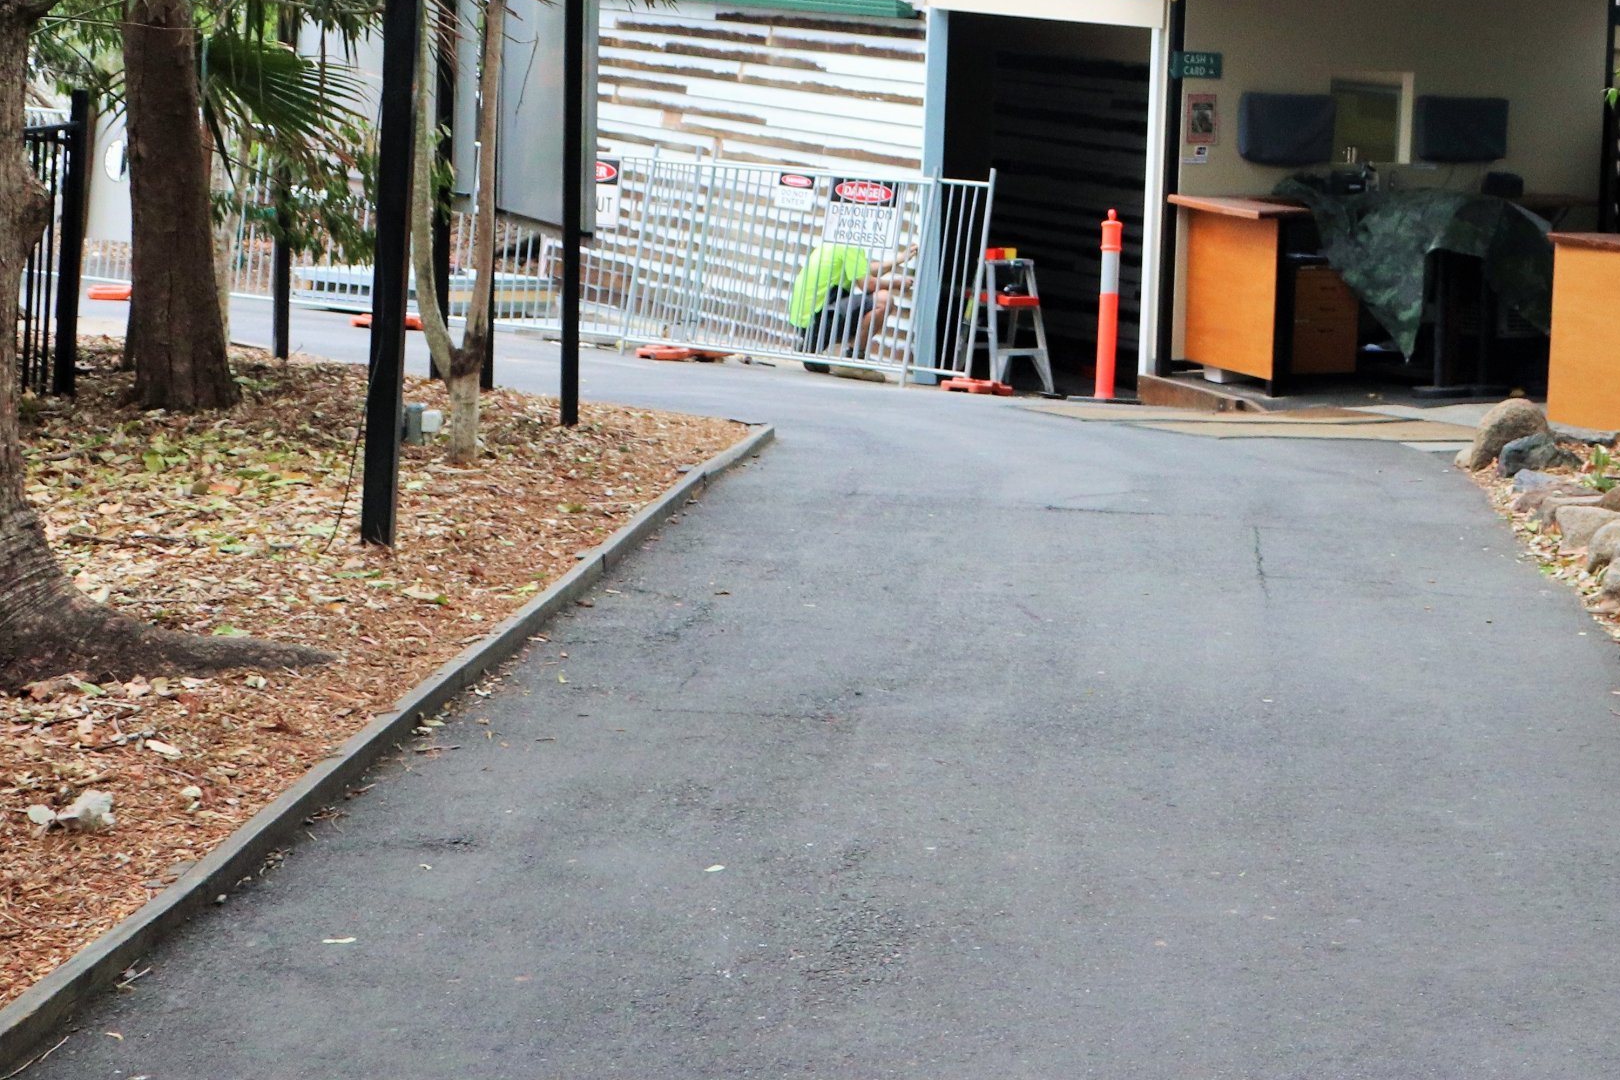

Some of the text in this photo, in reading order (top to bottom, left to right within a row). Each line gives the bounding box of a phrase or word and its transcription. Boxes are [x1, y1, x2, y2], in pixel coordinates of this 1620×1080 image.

[1183, 54, 1207, 65] CASH
[843, 186, 886, 200] DANGER
[595, 196, 613, 214] UT
[831, 204, 893, 220] DEMOLITION
